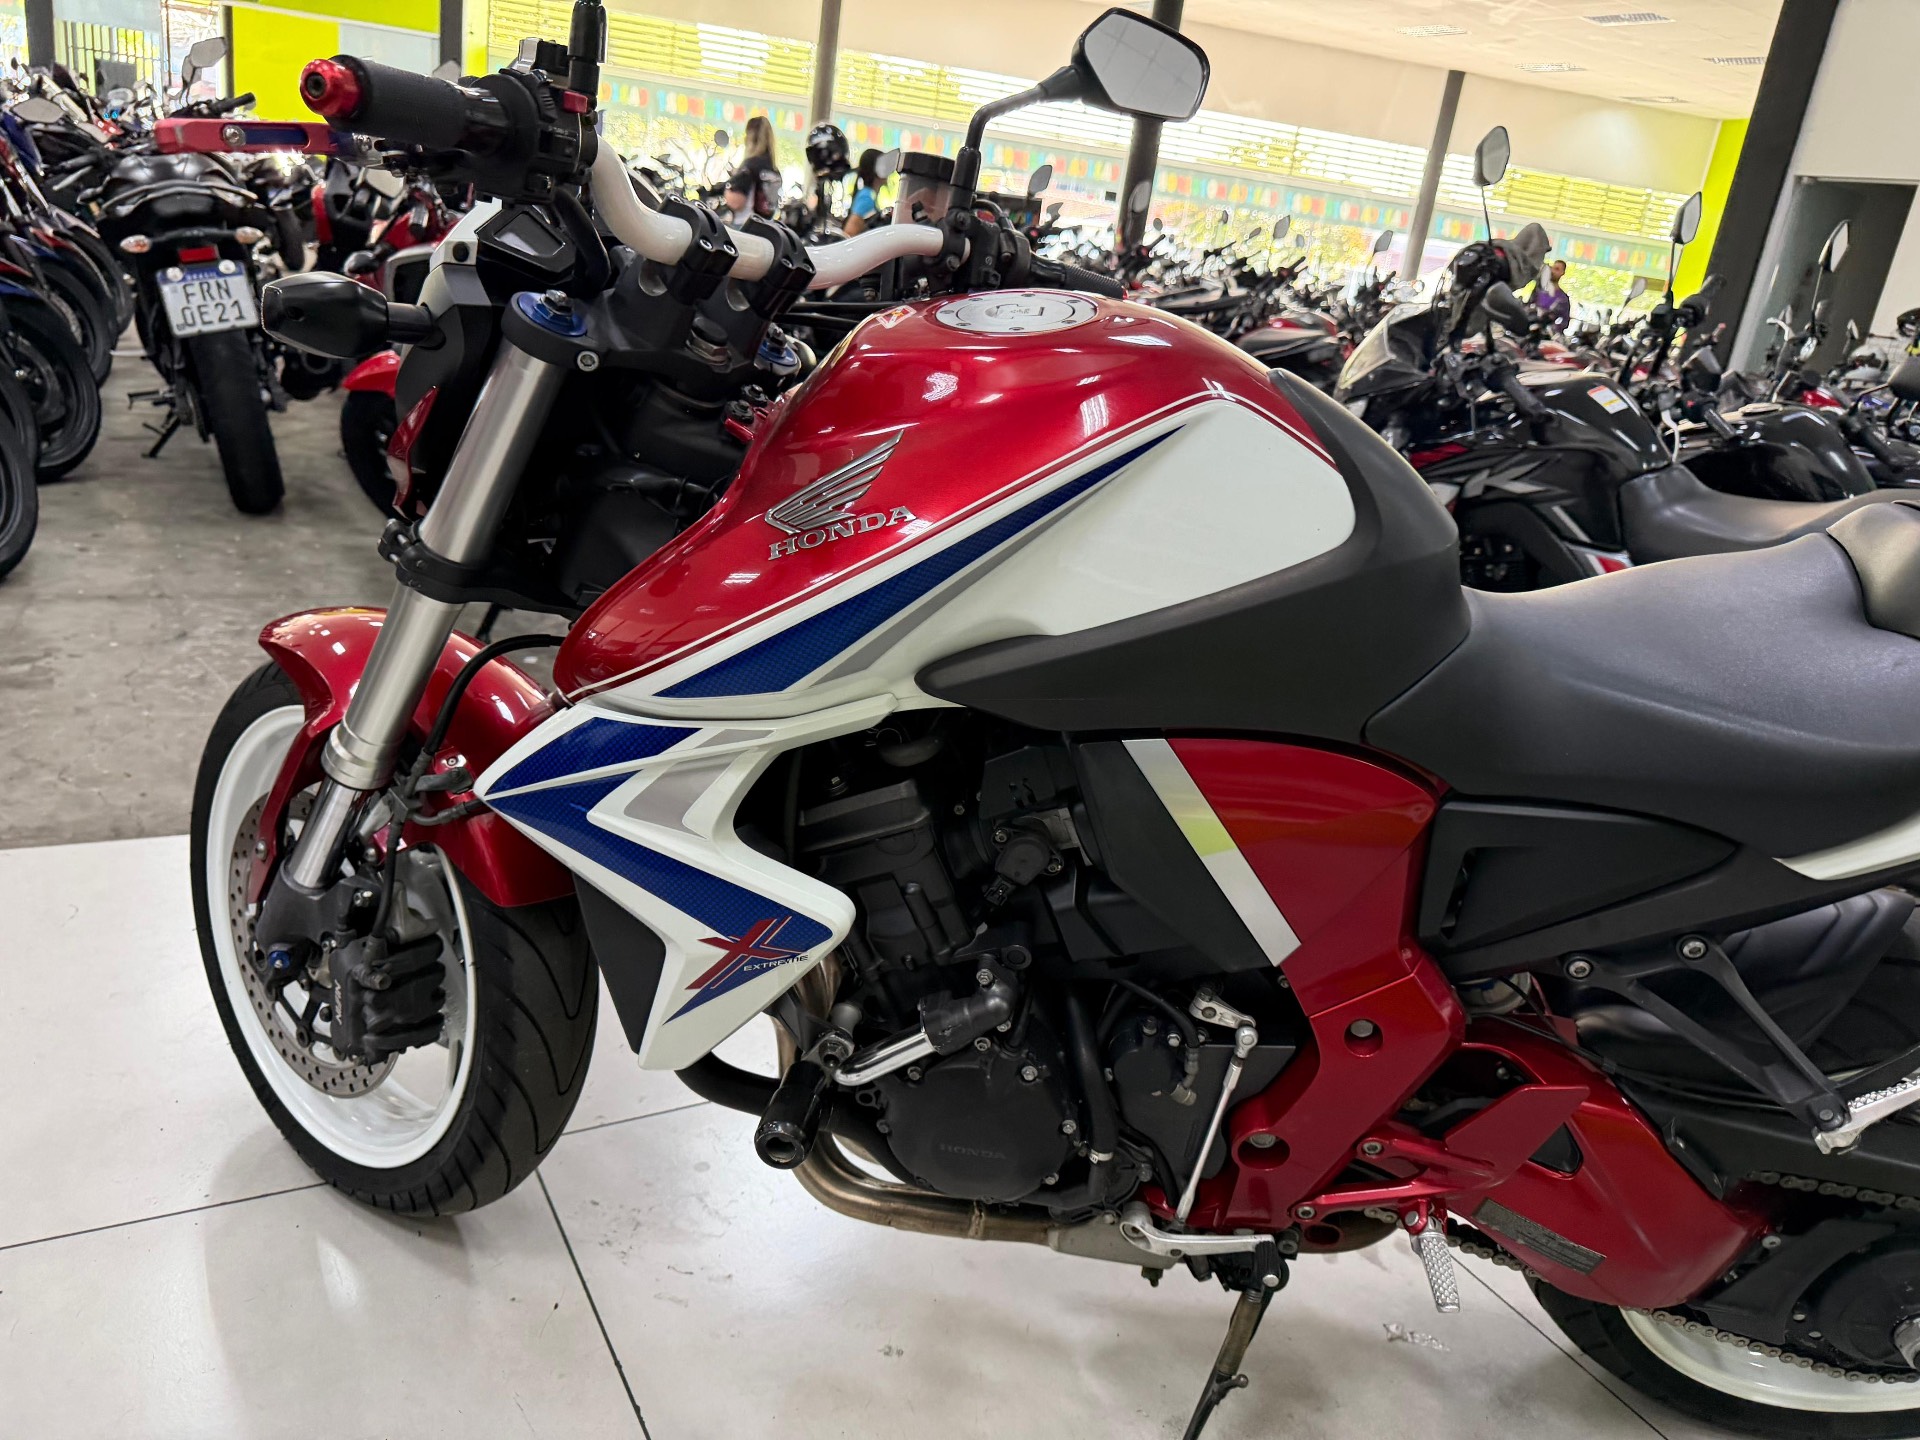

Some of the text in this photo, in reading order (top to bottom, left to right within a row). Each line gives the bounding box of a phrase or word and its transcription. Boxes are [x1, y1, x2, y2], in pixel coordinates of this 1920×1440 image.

[183, 279, 231, 304] FRN
[768, 505, 917, 560] HONDA
[743, 955, 809, 972] EXTREME
[940, 1143, 1007, 1160] HONDA
